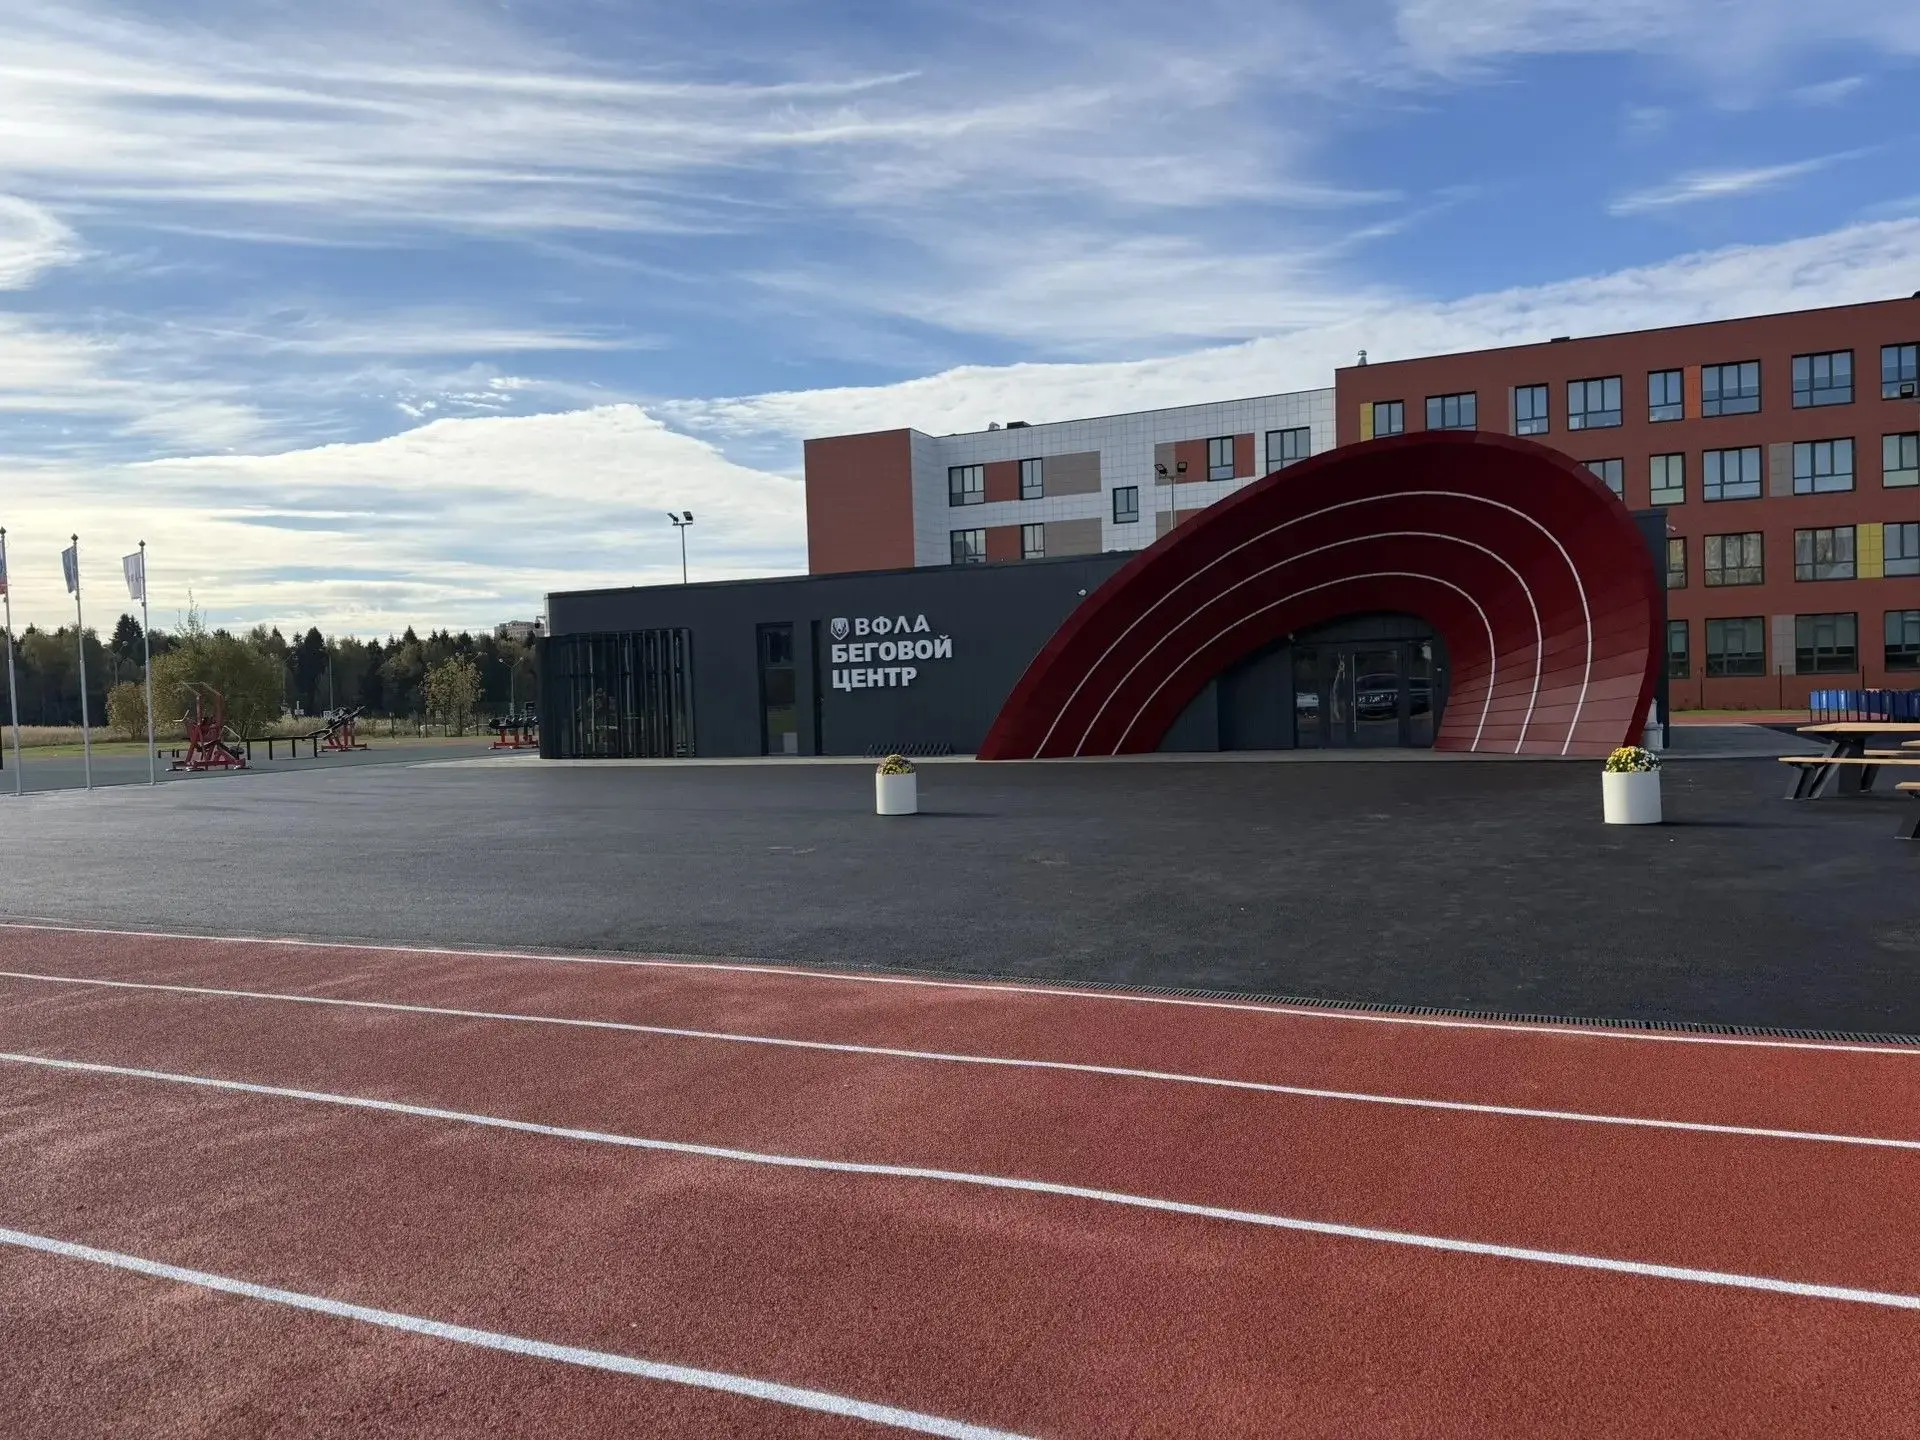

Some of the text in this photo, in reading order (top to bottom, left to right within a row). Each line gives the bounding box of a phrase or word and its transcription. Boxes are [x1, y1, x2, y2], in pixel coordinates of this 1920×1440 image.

[855, 614, 931, 636] ВФЛА
[831, 634, 953, 663] БЕГОВОЙ
[832, 667, 918, 692] ЦЕНТР
